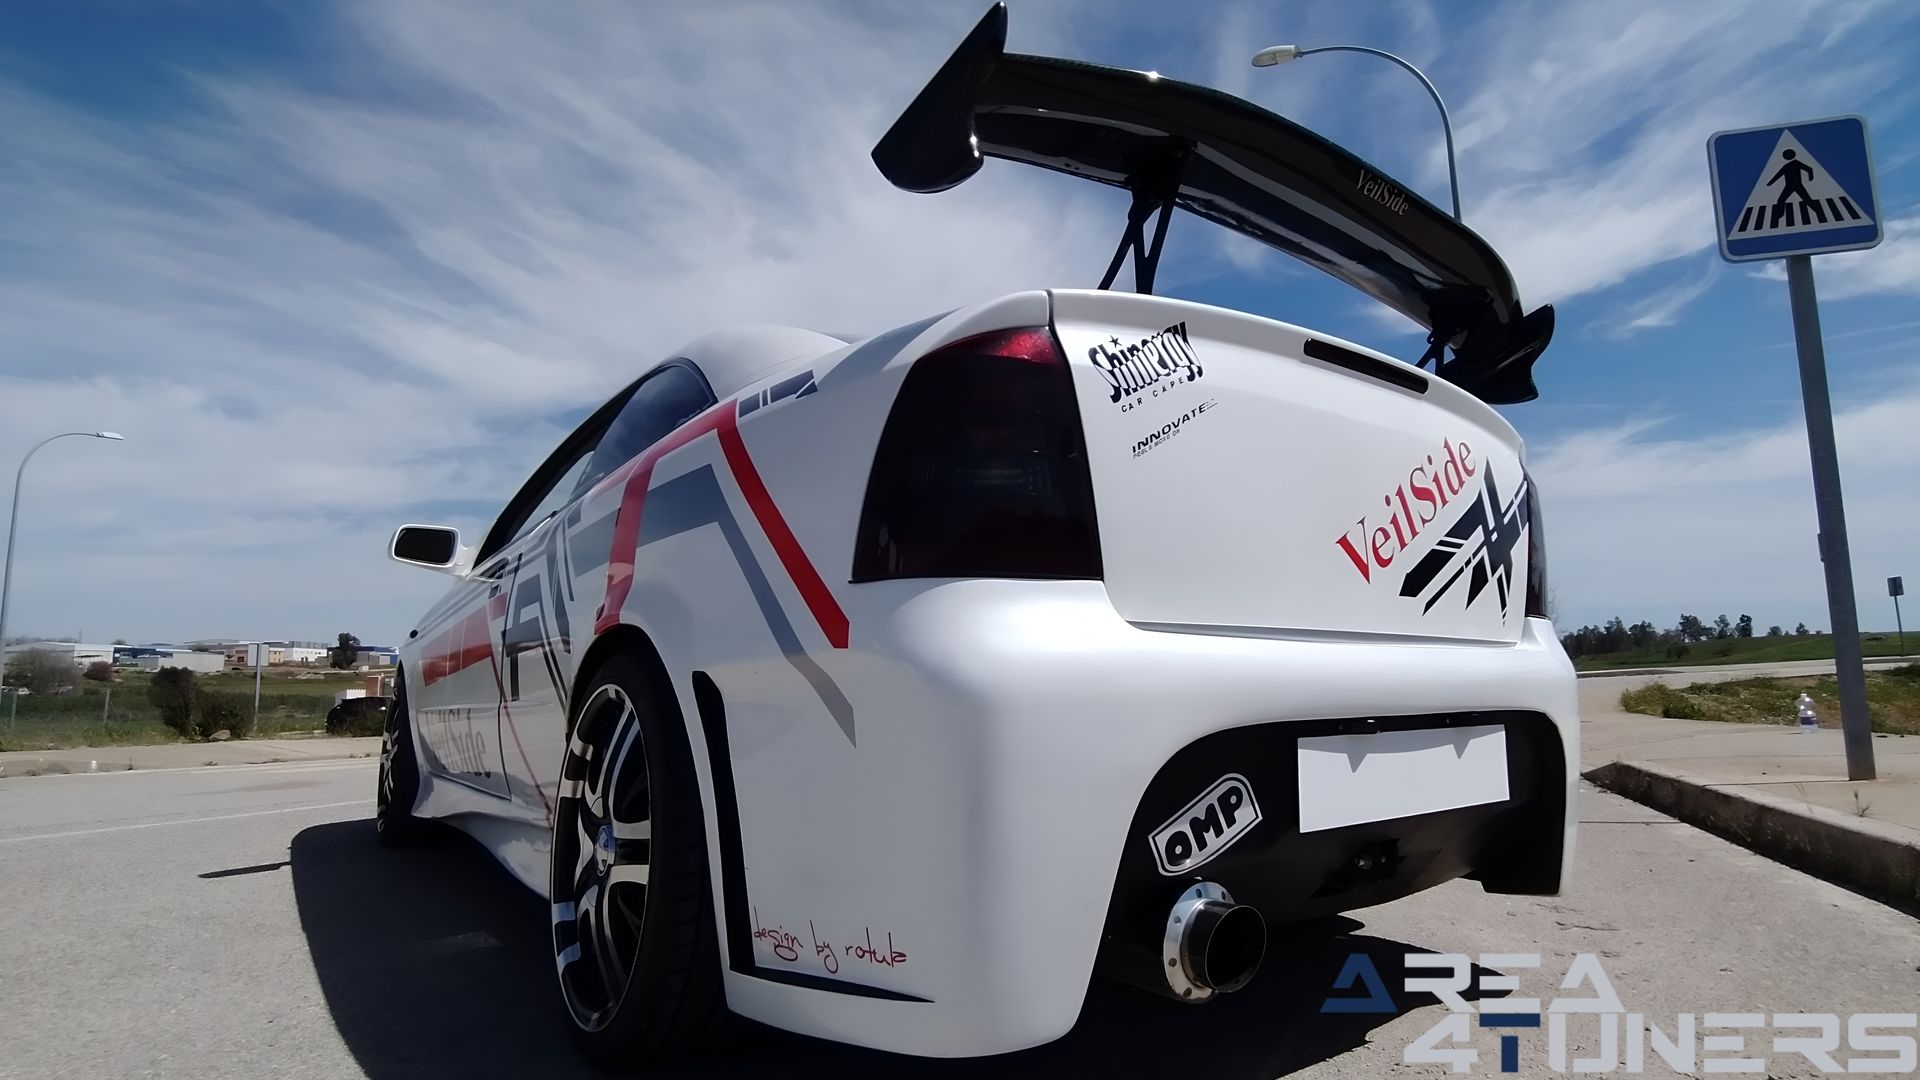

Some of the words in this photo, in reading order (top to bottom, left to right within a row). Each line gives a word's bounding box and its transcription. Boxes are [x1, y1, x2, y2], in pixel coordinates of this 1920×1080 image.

[1356, 169, 1409, 215] VeilSide
[1121, 397, 1143, 413] CAR
[1132, 401, 1209, 454] INNOVATE
[1335, 436, 1476, 585] VeilSide
[1164, 785, 1244, 867] OMP
[753, 905, 804, 962] design
[809, 919, 839, 974] by
